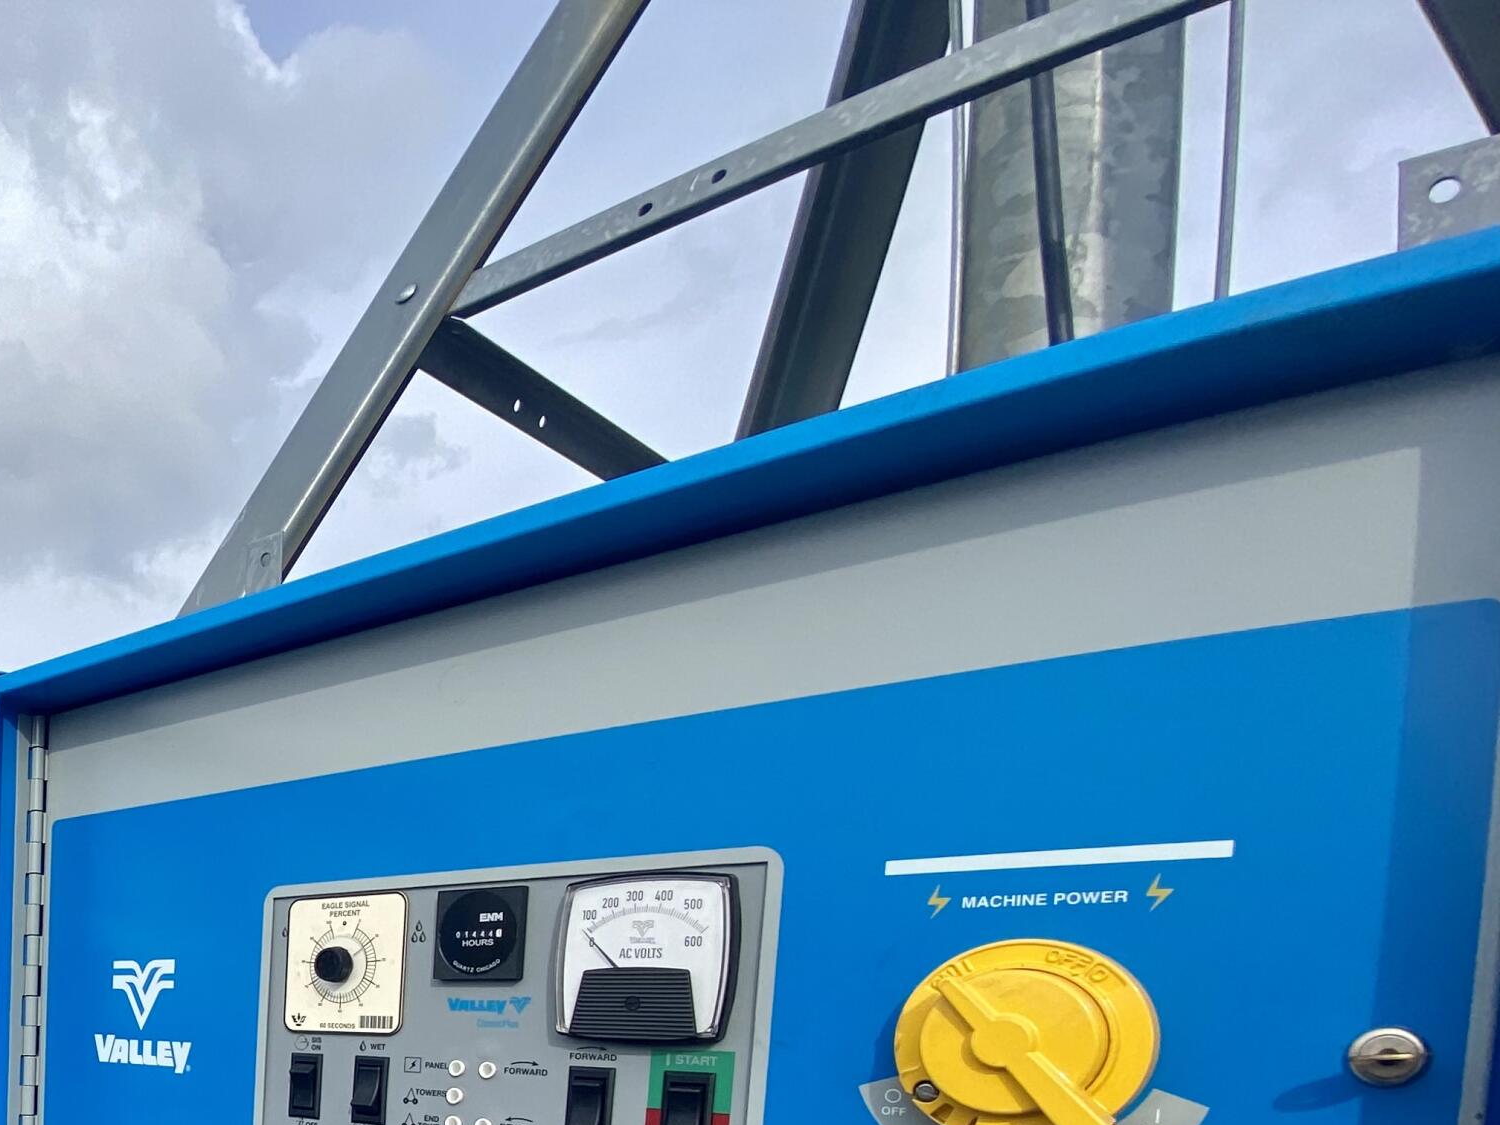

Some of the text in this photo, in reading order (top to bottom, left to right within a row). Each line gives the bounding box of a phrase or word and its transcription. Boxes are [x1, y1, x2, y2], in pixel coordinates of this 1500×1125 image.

[626, 891, 643, 901] 300
[655, 890, 673, 900] 400
[962, 890, 1129, 908] MACHINE POWER
[602, 898, 619, 908] 200
[684, 899, 702, 910] 500
[480, 912, 503, 922] ENM
[582, 910, 597, 920] 100
[462, 939, 494, 947] HOURS
[685, 936, 702, 947] 600
[619, 948, 662, 958] AC VOLTS
[453, 959, 500, 972] QUARTZ CHICAGO
[447, 998, 506, 1015] VALLEY
[94, 1034, 191, 1074] VALLEY
[570, 1053, 617, 1062] FORWARD
[675, 1055, 718, 1066] START
[425, 1062, 449, 1070] PANEL
[504, 1067, 548, 1077] FORWARD
[416, 1089, 447, 1098] TOWERS
[882, 1106, 907, 1116] OFF
